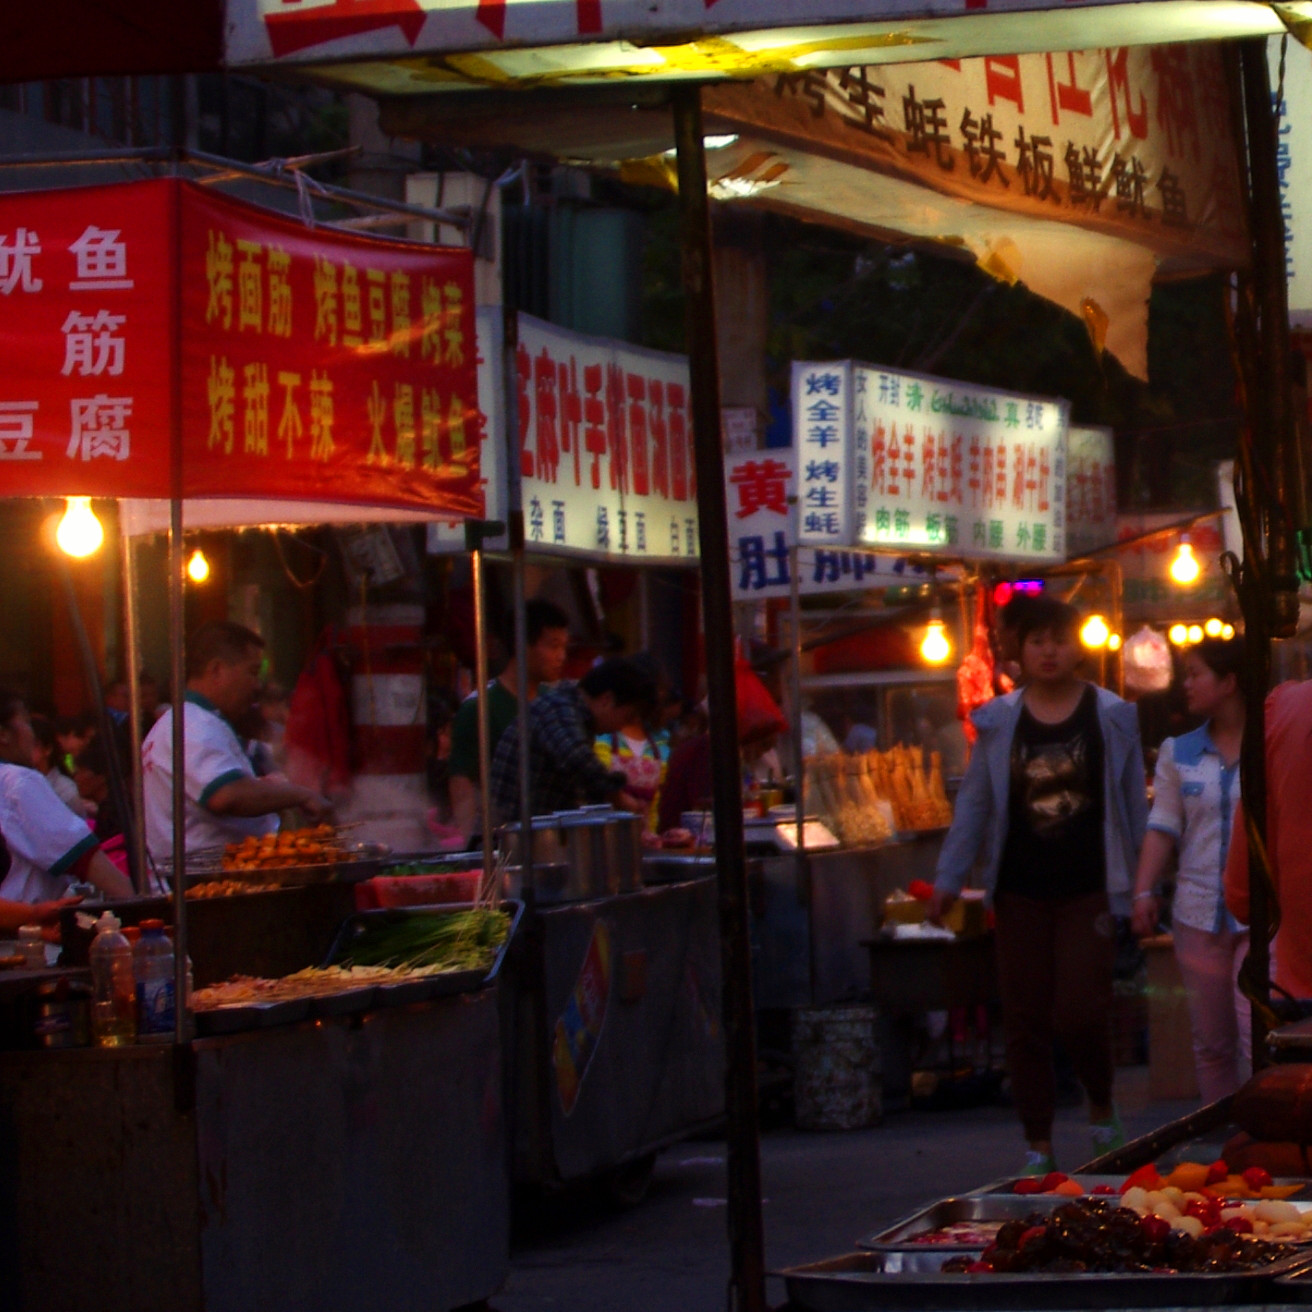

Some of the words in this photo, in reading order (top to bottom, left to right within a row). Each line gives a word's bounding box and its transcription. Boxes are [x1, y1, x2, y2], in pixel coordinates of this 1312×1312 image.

[60, 309, 127, 377] 筋
[805, 373, 840, 449] 烤全羊
[730, 458, 793, 519] 黄
